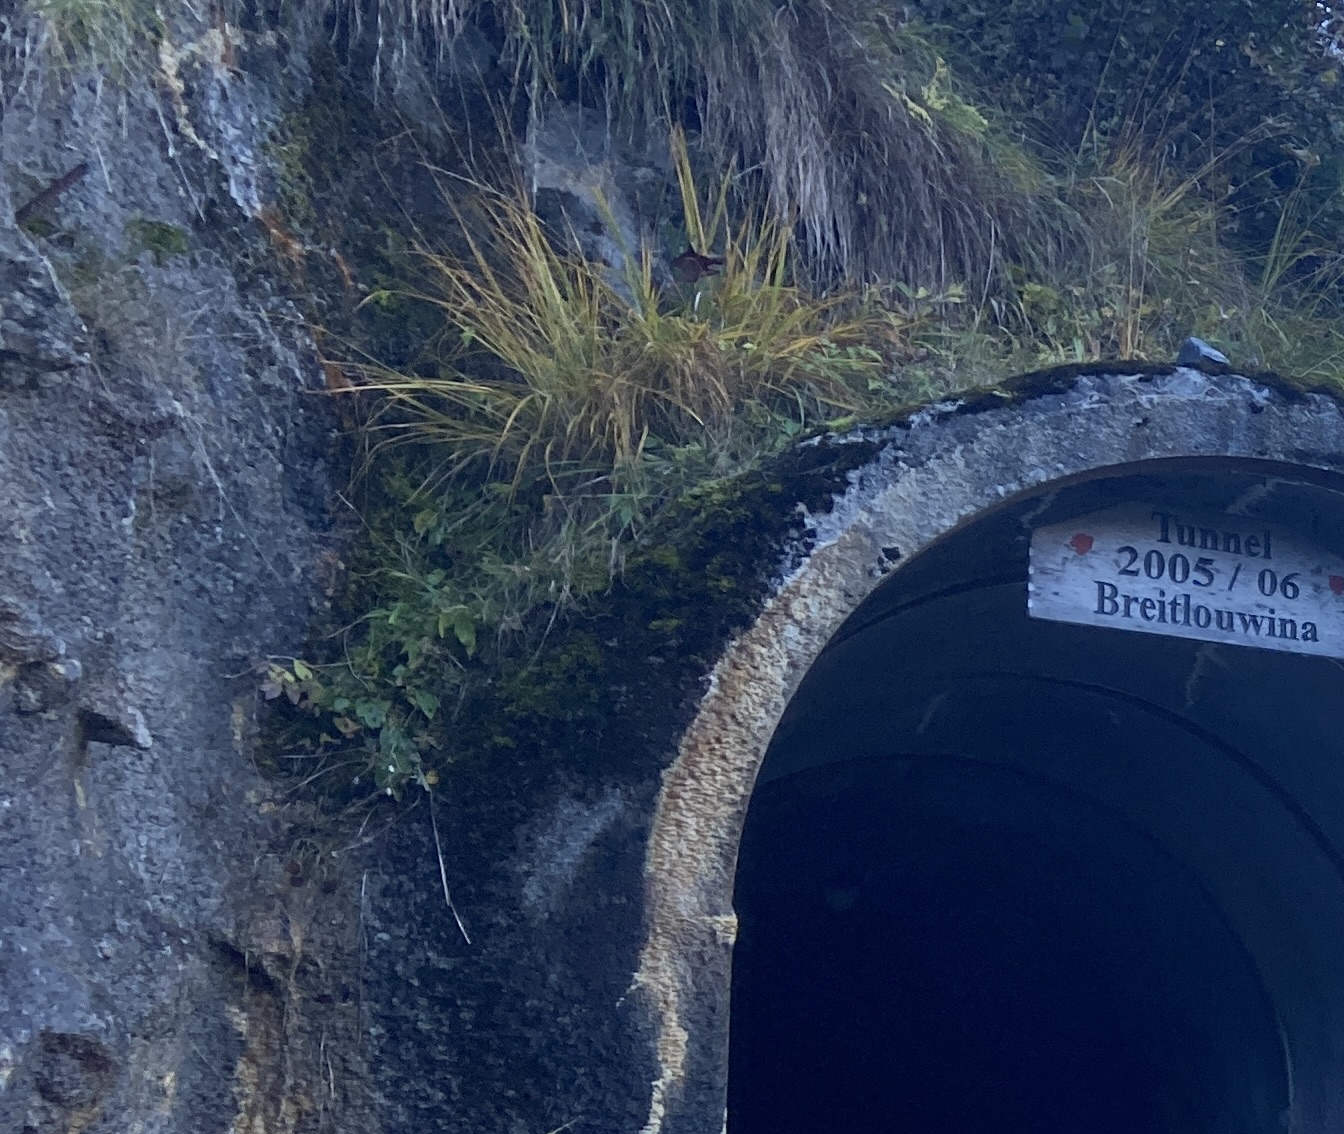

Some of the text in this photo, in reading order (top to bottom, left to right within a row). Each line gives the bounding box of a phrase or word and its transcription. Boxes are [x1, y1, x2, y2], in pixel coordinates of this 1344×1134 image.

[1151, 511, 1273, 560] Tunnel
[1117, 545, 1301, 600] 2005 / 06
[1094, 580, 1320, 643] Breitlouwina
